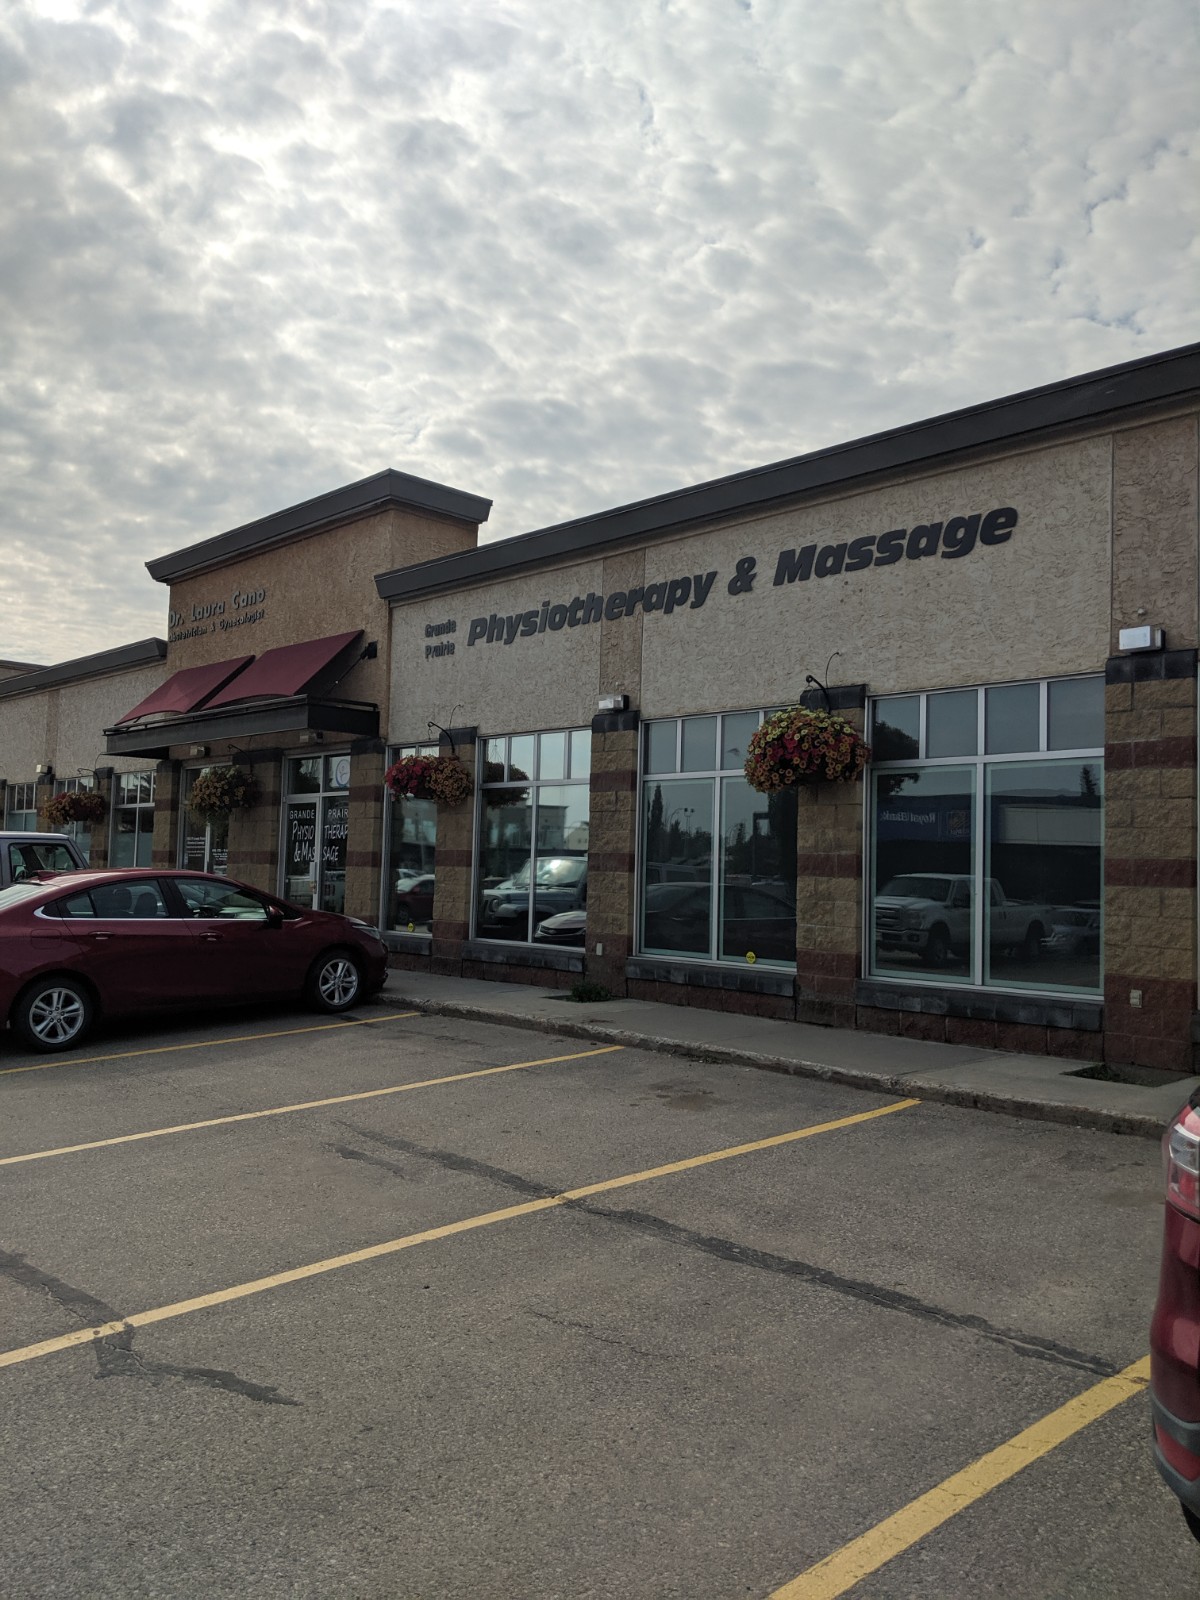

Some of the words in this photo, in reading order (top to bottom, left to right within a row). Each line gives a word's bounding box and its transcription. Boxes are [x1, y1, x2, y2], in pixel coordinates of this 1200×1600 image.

[467, 569, 718, 647] Physiotherapy
[727, 555, 758, 596] &
[773, 506, 1019, 587] Massage
[169, 610, 185, 629] Dr.
[191, 601, 226, 622] Laura
[232, 589, 266, 610] Cano
[219, 609, 265, 632] Gynecologist
[425, 618, 457, 638] Grande
[425, 640, 456, 660] Prairie
[289, 809, 315, 819] GRANDE
